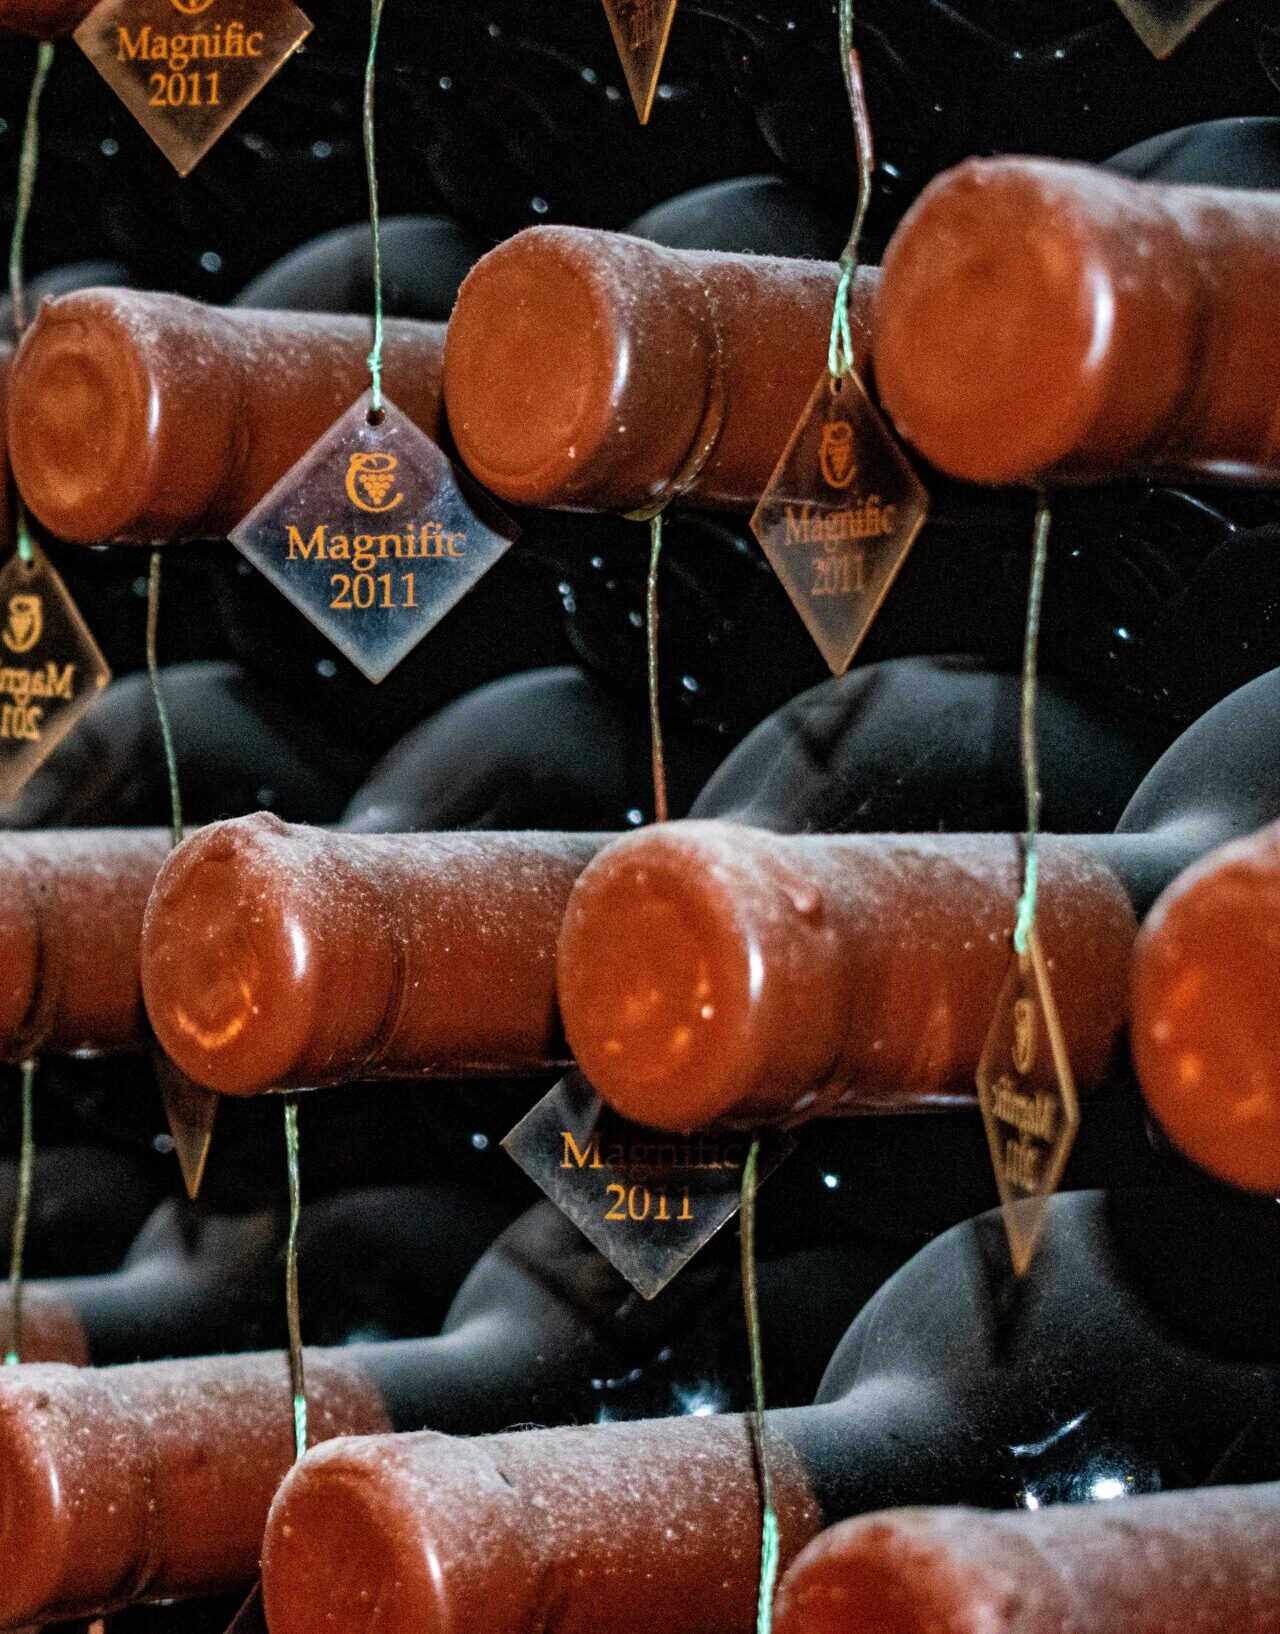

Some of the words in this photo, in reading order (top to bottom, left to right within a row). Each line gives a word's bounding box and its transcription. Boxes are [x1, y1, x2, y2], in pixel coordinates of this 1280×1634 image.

[117, 21, 264, 71] Magnific
[149, 71, 221, 107] 2011
[784, 494, 895, 552] Magnific
[285, 521, 467, 572] Magnific
[330, 573, 419, 610] 2011
[811, 553, 865, 596] 2011
[603, 1183, 695, 1221] 2011
